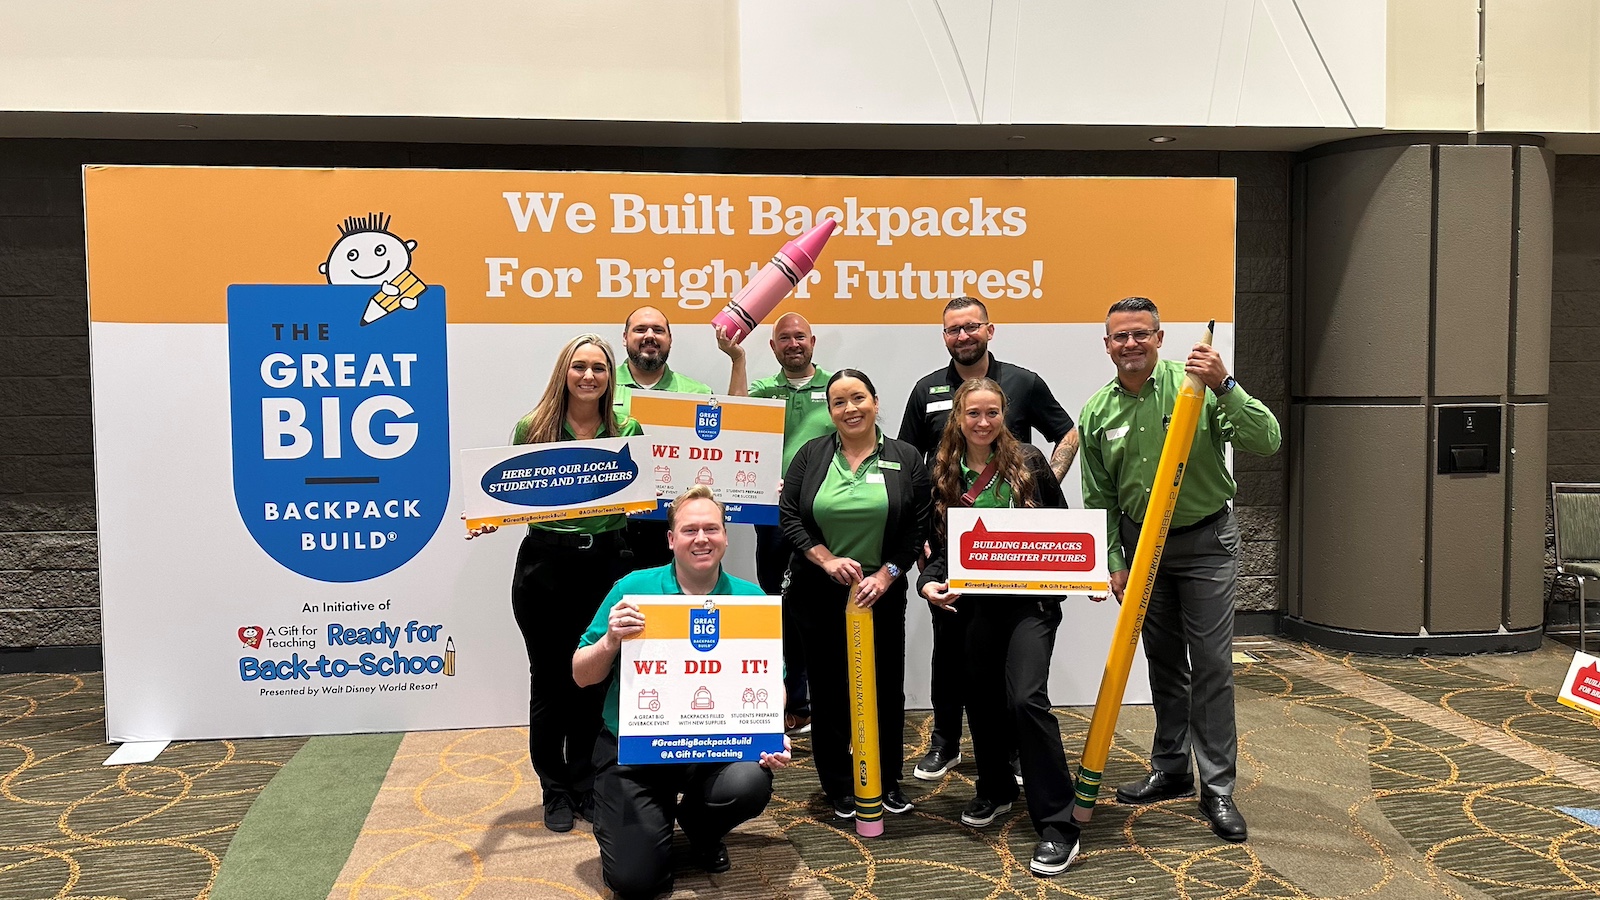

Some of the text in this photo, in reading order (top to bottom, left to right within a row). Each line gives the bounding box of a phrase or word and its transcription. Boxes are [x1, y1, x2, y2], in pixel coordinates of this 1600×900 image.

[503, 191, 1028, 246] We Built Backpacks
[484, 257, 583, 299] For
[833, 259, 1044, 301] Futures!
[272, 323, 329, 341] THE
[260, 353, 417, 389] GREAT
[261, 394, 419, 460] BIG
[698, 417, 718, 427] BIG
[652, 444, 760, 464] WE DID IT!
[501, 460, 619, 480] HERE FOR OUR LOCAL
[489, 471, 633, 493] STUDENTS AND TEACHERS
[264, 499, 421, 521] BACKPACK
[503, 511, 567, 523] #GreatBigBackpackBuild
[972, 540, 1083, 551] BUILDING BACKPACKS
[968, 552, 1087, 563] FOR BRIGHTER FUTURES
[964, 582, 1028, 590] #GreatBigBackpackBuild
[1130, 613, 1144, 646] DIXON
[1139, 544, 1163, 610] TICONDEROGA
[302, 599, 391, 613] An Initiative of
[266, 625, 318, 637] A Gift for
[327, 620, 443, 648] Ready for
[693, 624, 716, 635] BIG
[852, 620, 862, 649] DIXON
[266, 637, 316, 649] Teaching
[633, 659, 769, 675] WE DID IT!
[260, 682, 439, 697] Presented by Walt Disney World Resort
[854, 650, 865, 717] TICONDEROGA
[1578, 685, 1592, 695] FOR
[651, 736, 753, 748] #GreatBigBackpackBuild
[660, 749, 743, 760] @A Gift For Teaching
